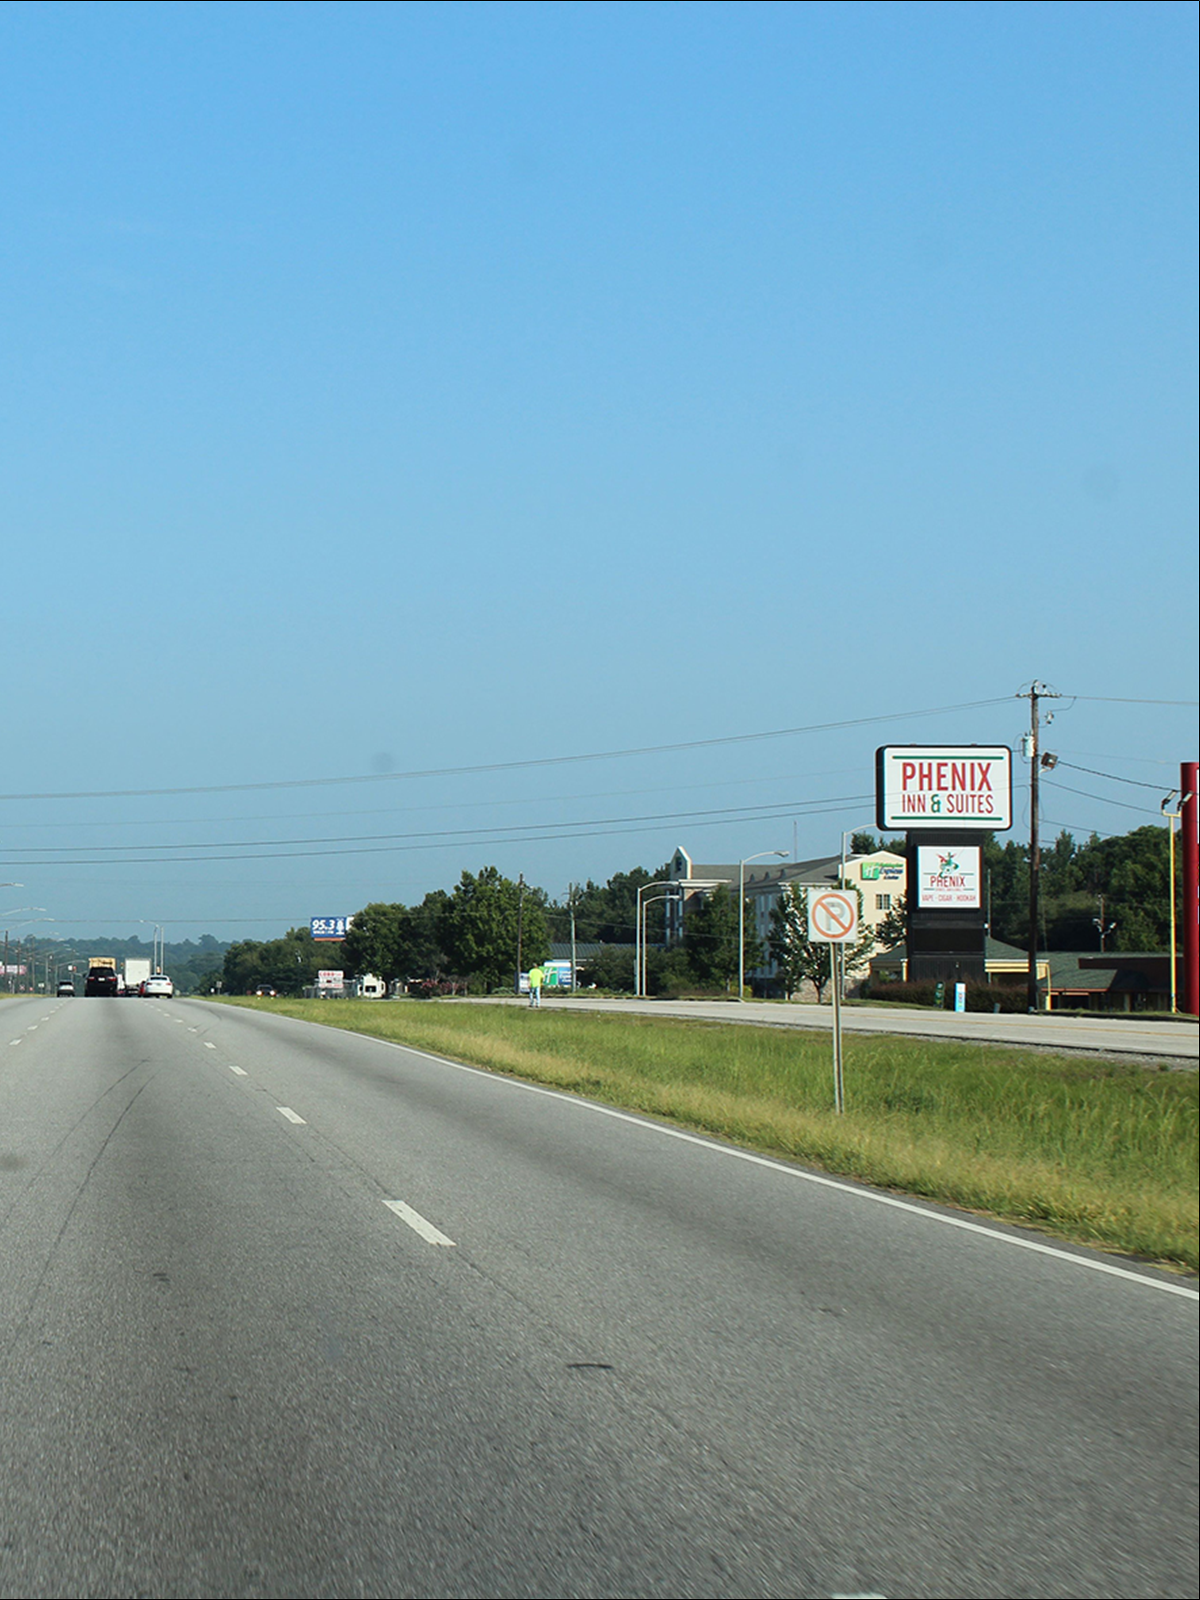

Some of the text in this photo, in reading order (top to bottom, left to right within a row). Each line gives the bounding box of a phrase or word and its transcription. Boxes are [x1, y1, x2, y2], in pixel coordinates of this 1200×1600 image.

[902, 762, 992, 791] PHENIX
[902, 793, 994, 814] INN & SUITES
[930, 875, 966, 888] PHENIX
[312, 919, 336, 931] 95.3
